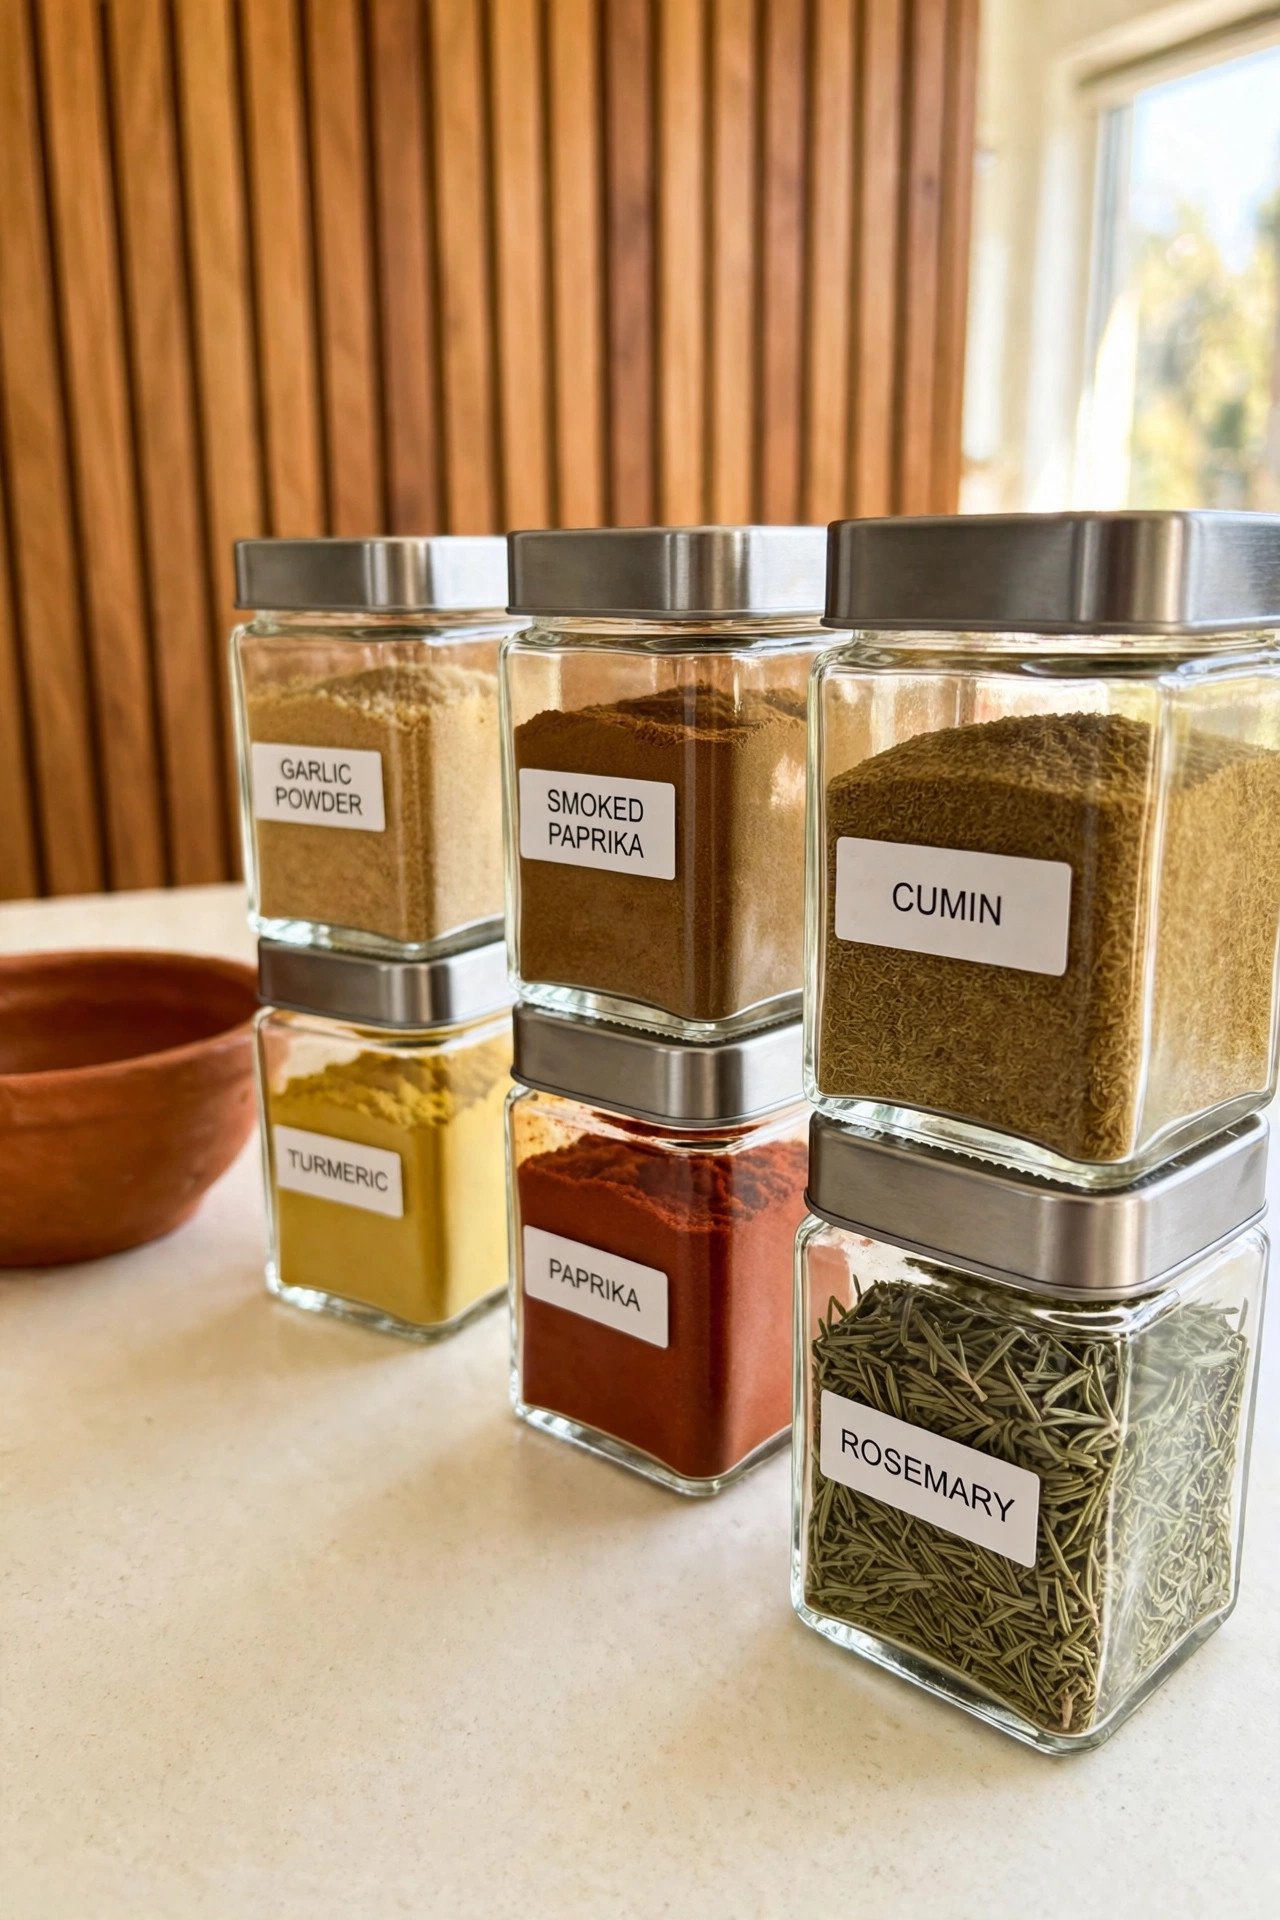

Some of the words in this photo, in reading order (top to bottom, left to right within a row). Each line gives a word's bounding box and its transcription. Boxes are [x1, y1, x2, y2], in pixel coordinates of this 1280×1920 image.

[280, 758, 352, 785] GARLIC
[275, 786, 363, 815] POWDER
[547, 788, 644, 823] SMOKED
[548, 821, 645, 858] PAPRIKA
[892, 882, 1002, 927] CUMIN
[287, 1148, 388, 1192] TURMERIC
[549, 1258, 641, 1312] PAPRIKA
[841, 1428, 1016, 1523] ROSEMARY
